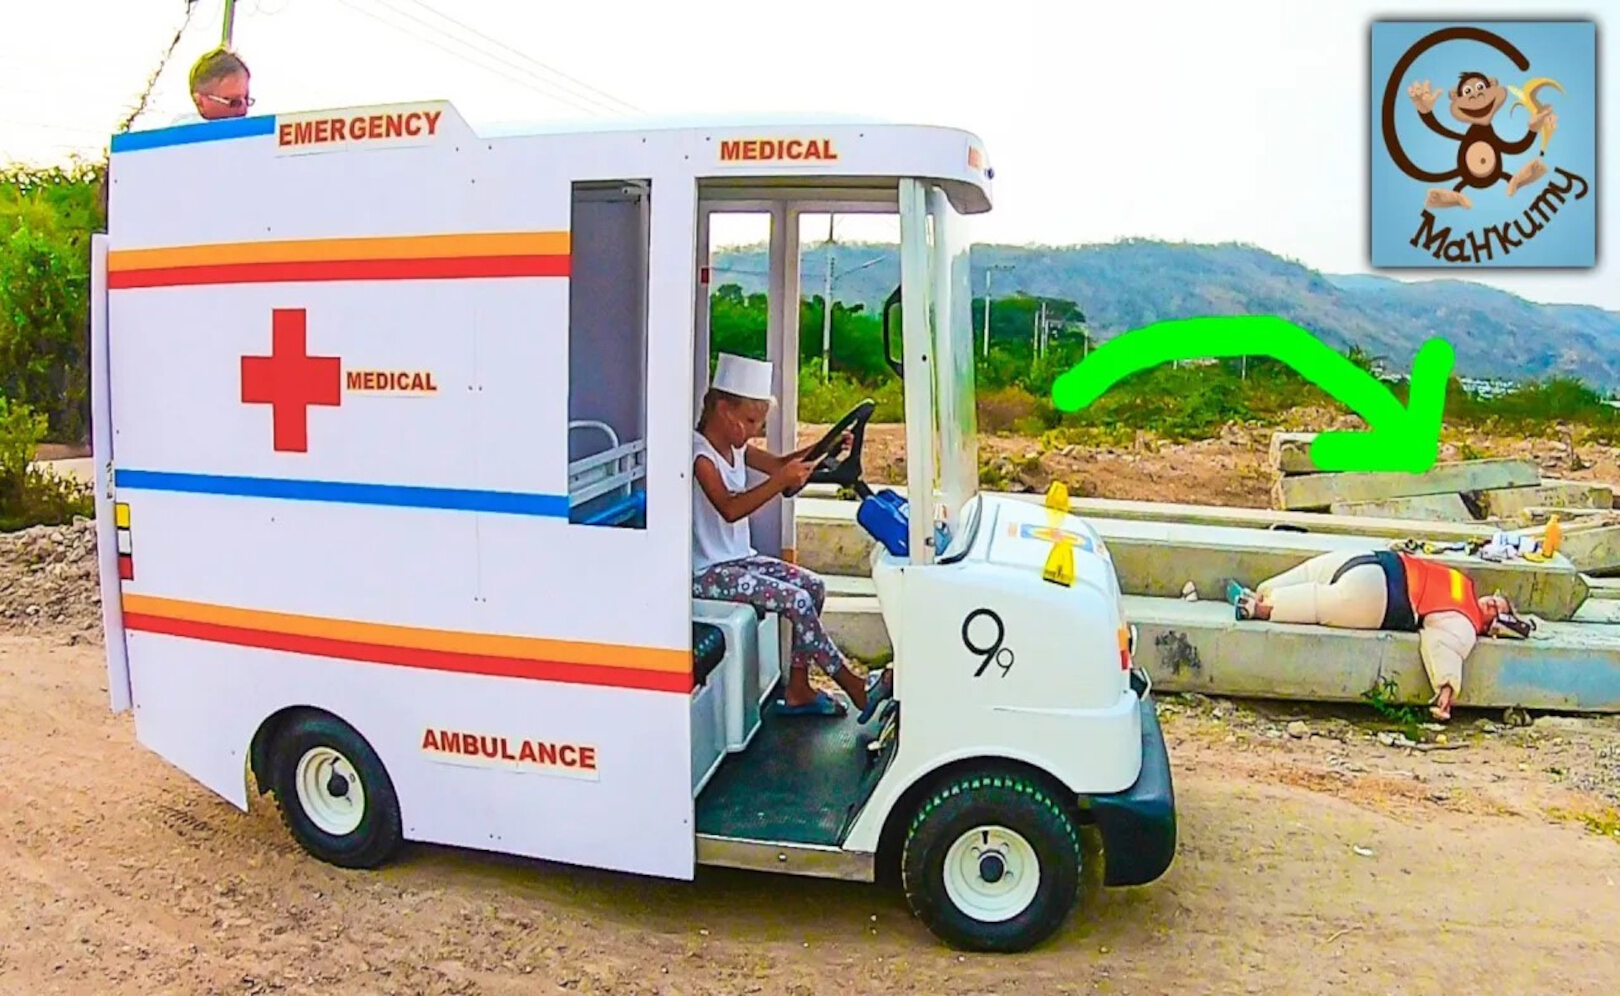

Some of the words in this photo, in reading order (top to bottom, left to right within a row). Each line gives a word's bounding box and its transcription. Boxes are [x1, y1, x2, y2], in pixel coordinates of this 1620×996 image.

[279, 111, 442, 146] EMERGENCY
[719, 138, 837, 161] MEDICAL
[346, 371, 438, 392] MEDICAL
[422, 728, 597, 770] AMBULANCE
